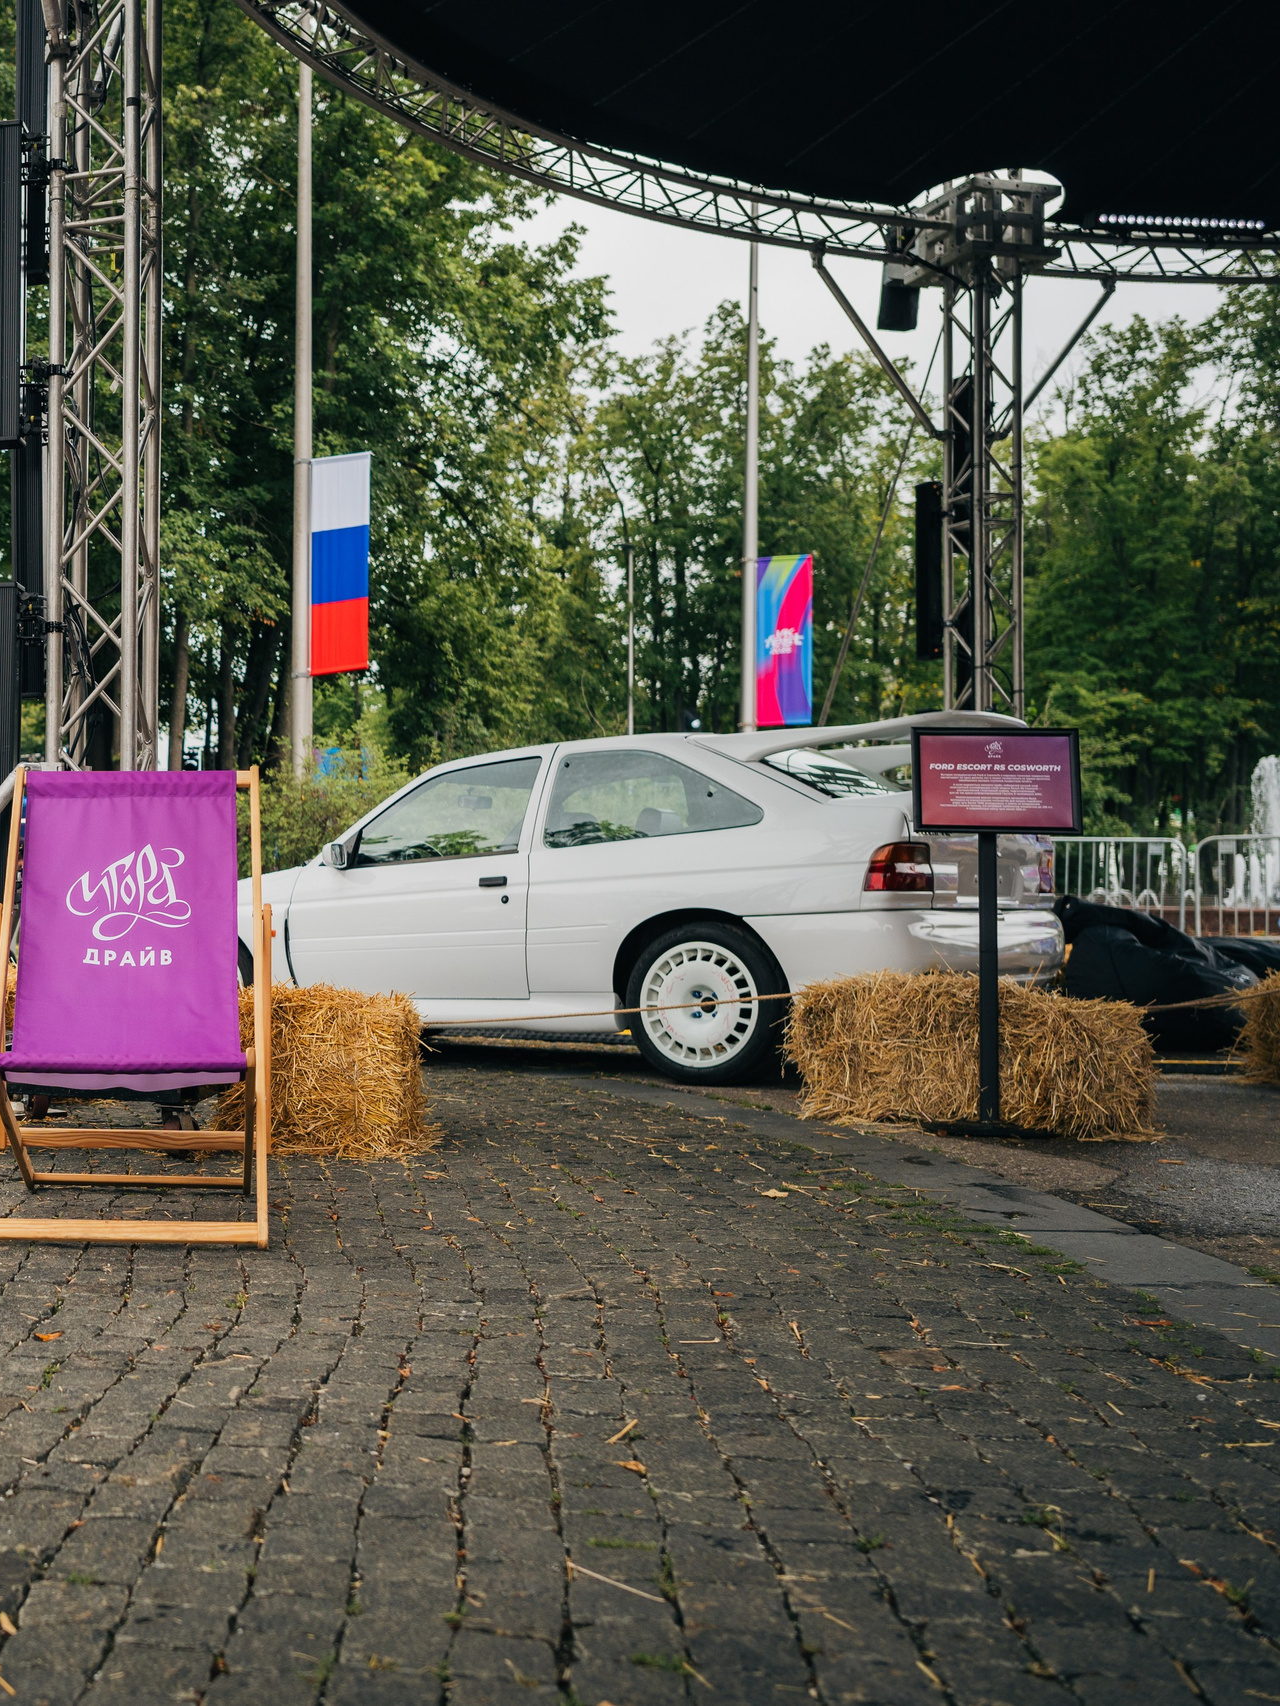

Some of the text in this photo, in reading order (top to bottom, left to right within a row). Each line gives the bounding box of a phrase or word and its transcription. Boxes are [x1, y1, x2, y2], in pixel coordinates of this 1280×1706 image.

[929, 762, 1062, 772] FORD ESCORT RS COSWORTH
[82, 946, 173, 967] ДРАЙВ
